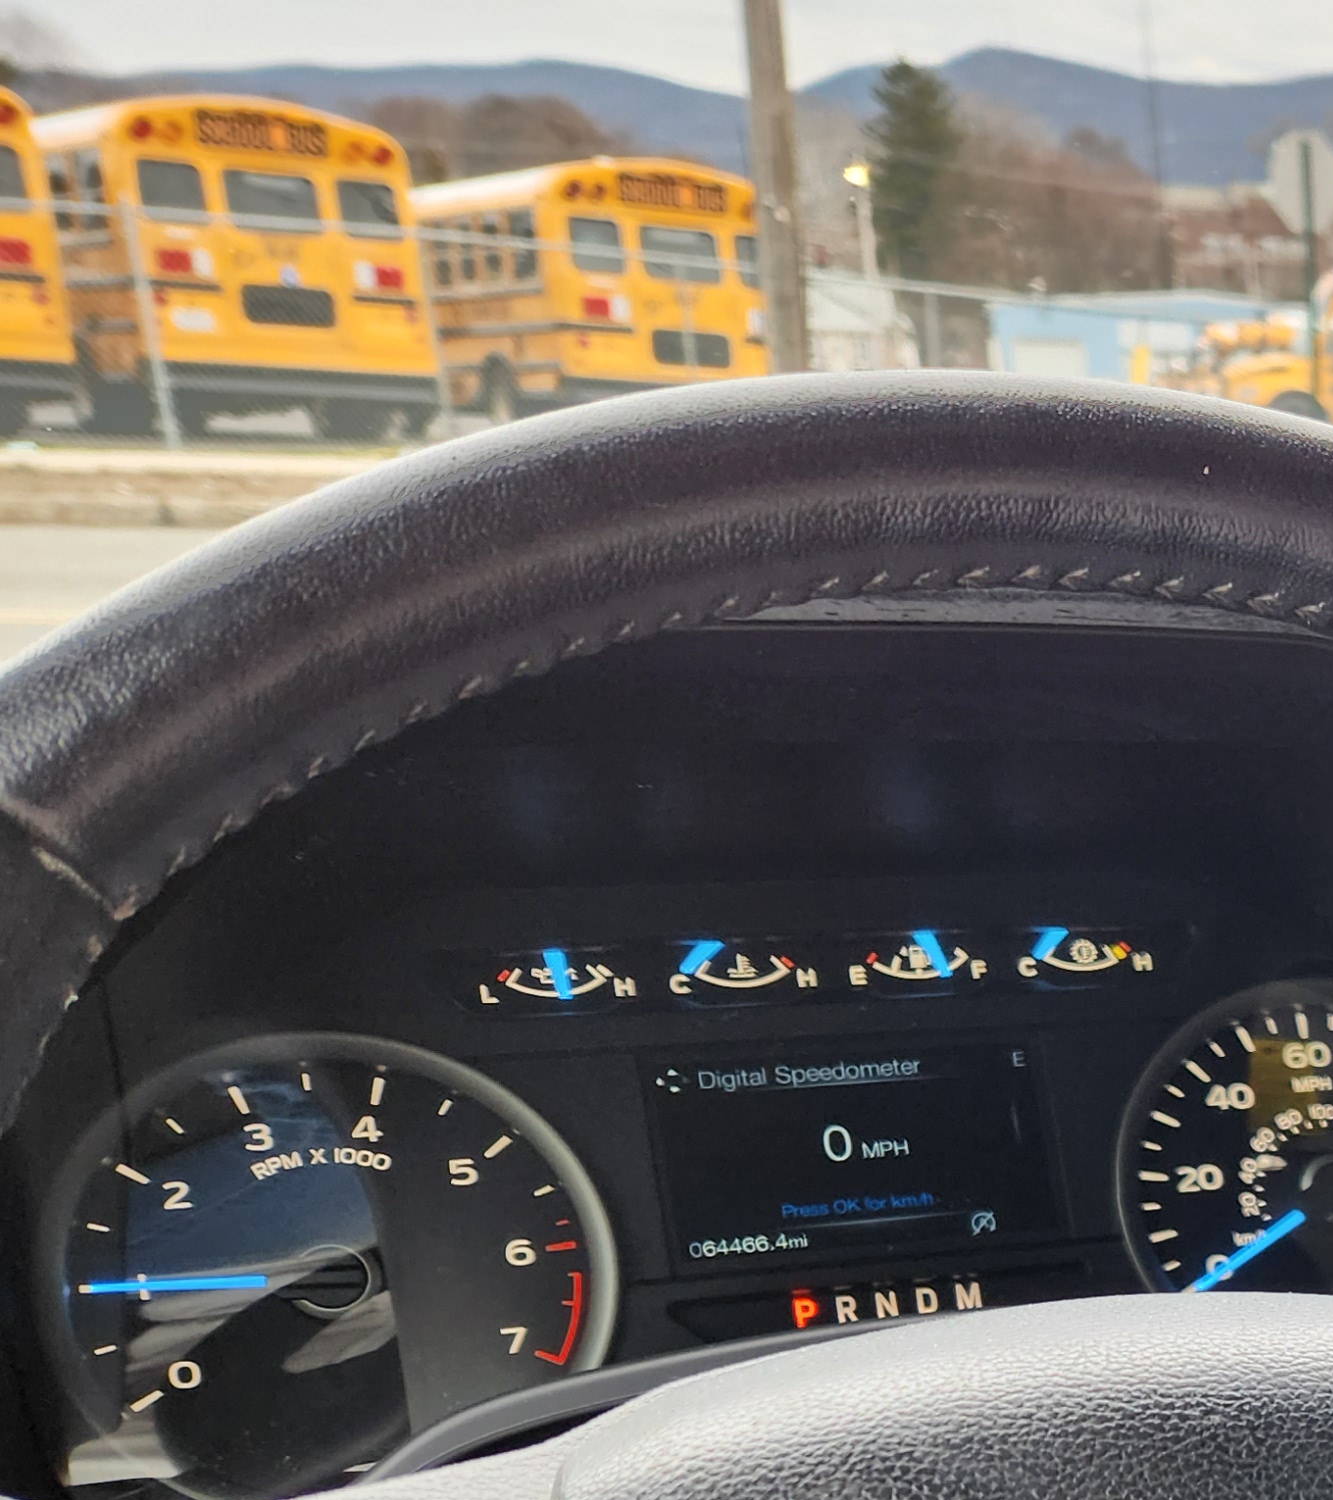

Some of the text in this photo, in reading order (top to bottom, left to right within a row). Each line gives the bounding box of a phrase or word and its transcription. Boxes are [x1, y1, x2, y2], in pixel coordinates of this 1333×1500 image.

[849, 964, 869, 986] E
[970, 960, 988, 980] F
[1017, 956, 1039, 977] C
[1131, 952, 1154, 972] H
[613, 976, 637, 997] H
[669, 973, 692, 994] C
[796, 967, 819, 988] H
[478, 983, 500, 1004] L
[1282, 1041, 1332, 1069] 60
[698, 1058, 921, 1092] Digital Speedometer
[1290, 1075, 1333, 1093] MPH
[1204, 1082, 1255, 1111] 40
[351, 1115, 384, 1142] 4
[1274, 1108, 1303, 1131] 80
[242, 1122, 274, 1151] 3
[822, 1124, 910, 1163] 0 MPH
[1250, 1127, 1276, 1153] 60
[250, 1146, 392, 1180] RPM X 1000
[448, 1157, 479, 1186] 5
[1175, 1163, 1224, 1193] 20
[161, 1180, 194, 1210] 2
[781, 1191, 934, 1219] Press OK for km/h
[505, 1238, 537, 1266] 6
[792, 1281, 983, 1329] P R N D M
[499, 1325, 529, 1355] 7
[168, 1360, 202, 1389] 0
